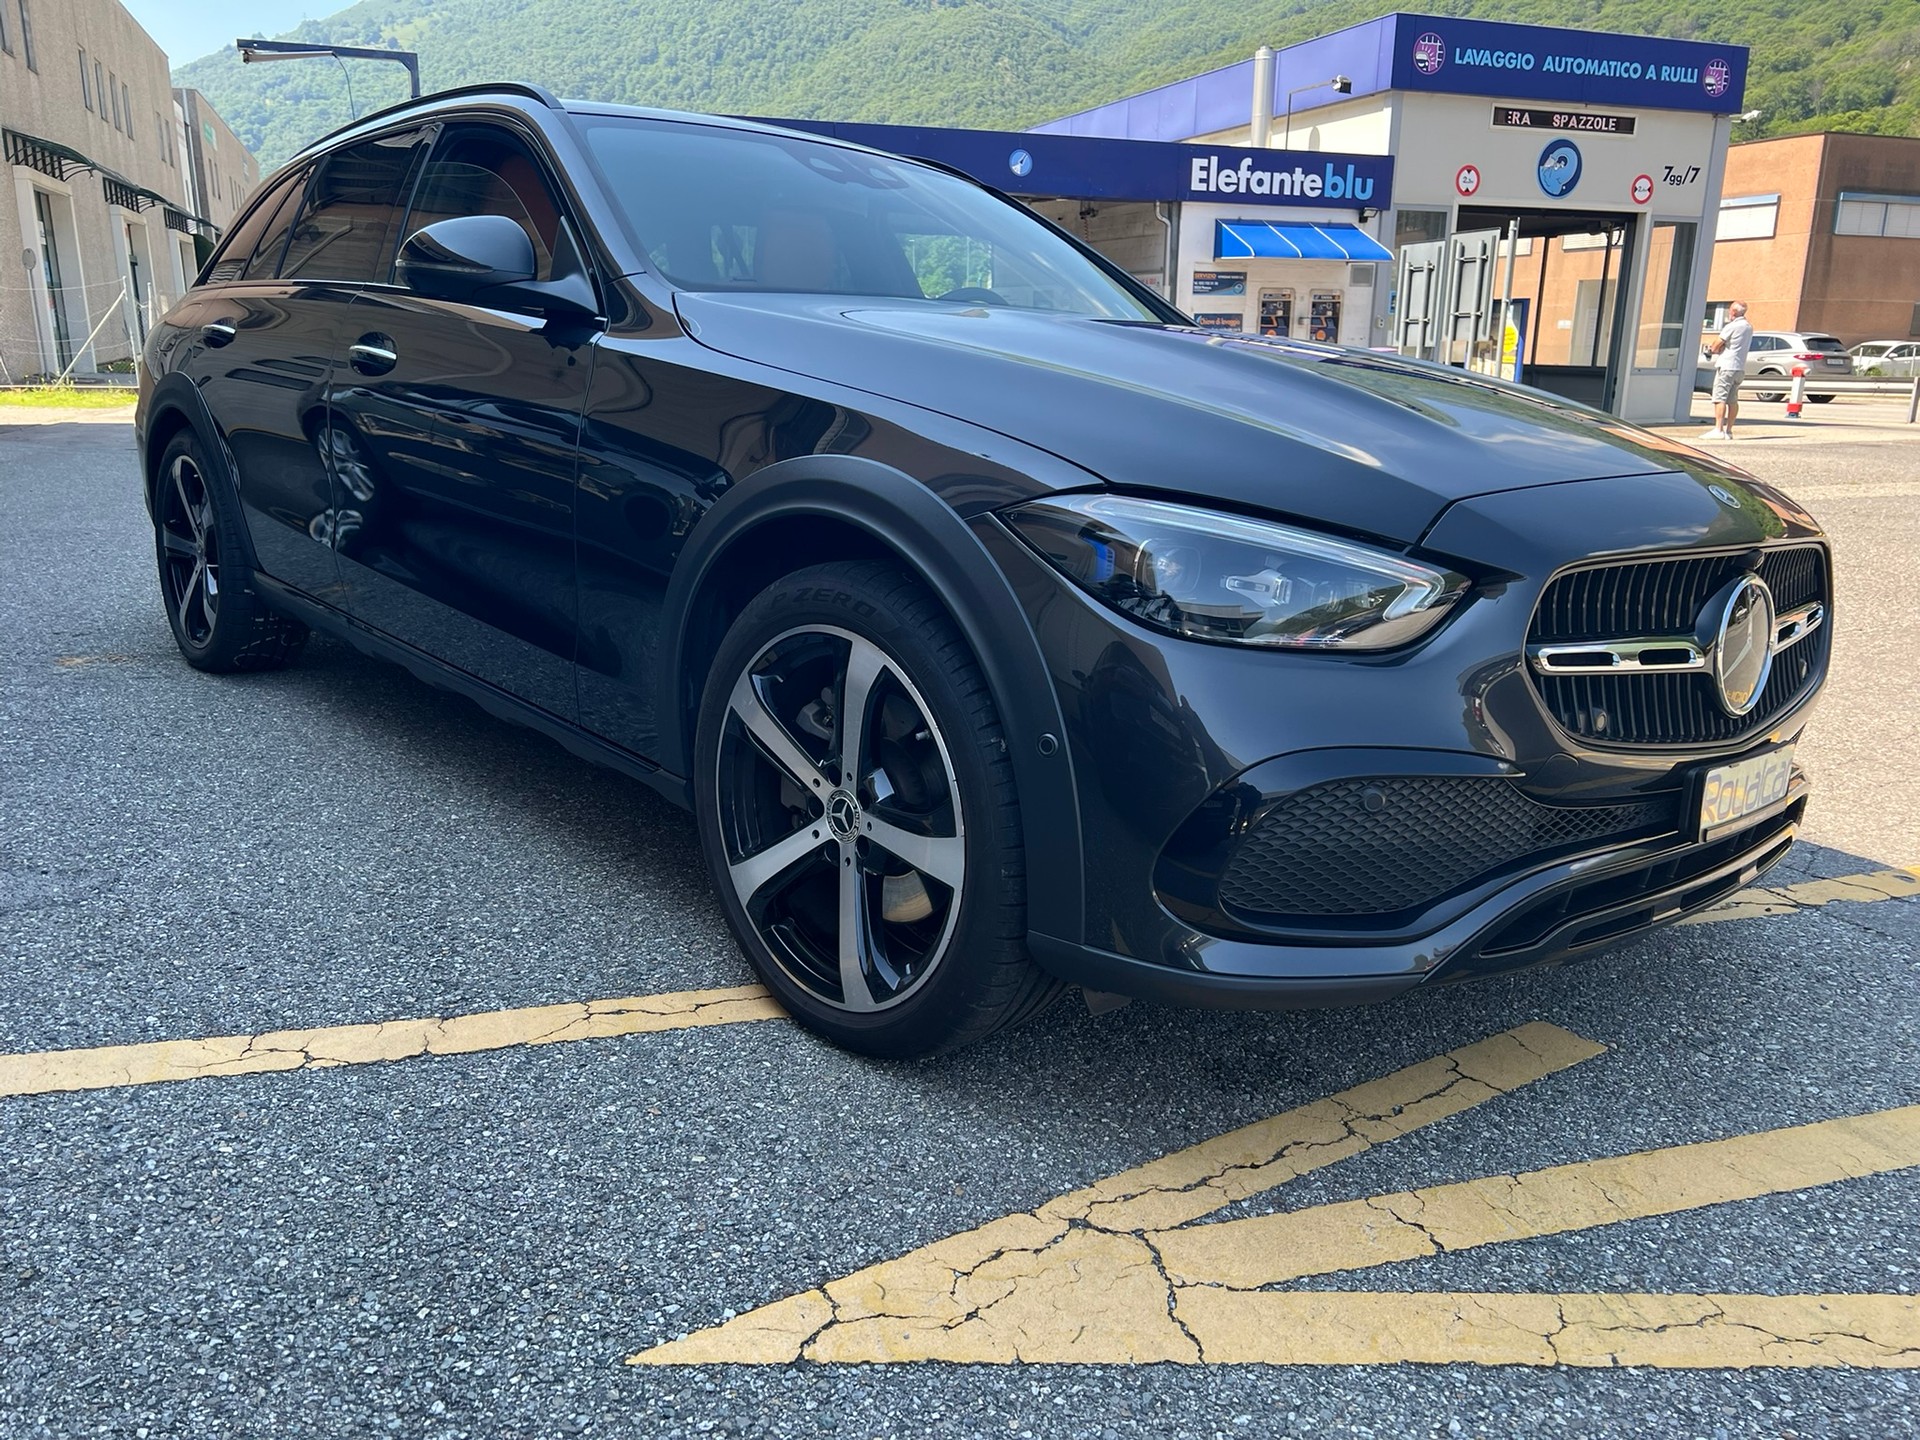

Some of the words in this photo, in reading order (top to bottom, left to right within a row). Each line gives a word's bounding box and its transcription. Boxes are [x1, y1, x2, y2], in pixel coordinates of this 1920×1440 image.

[1455, 47, 1535, 71] LAVAGGIO
[1542, 55, 1642, 79] AUTOMATICO
[1645, 64, 1657, 81] A
[1661, 65, 1698, 84] RULLI
[1552, 113, 1617, 131] SPAZZOLE
[1663, 165, 1701, 186] 7gg/7
[792, 587, 878, 618] ZERO
